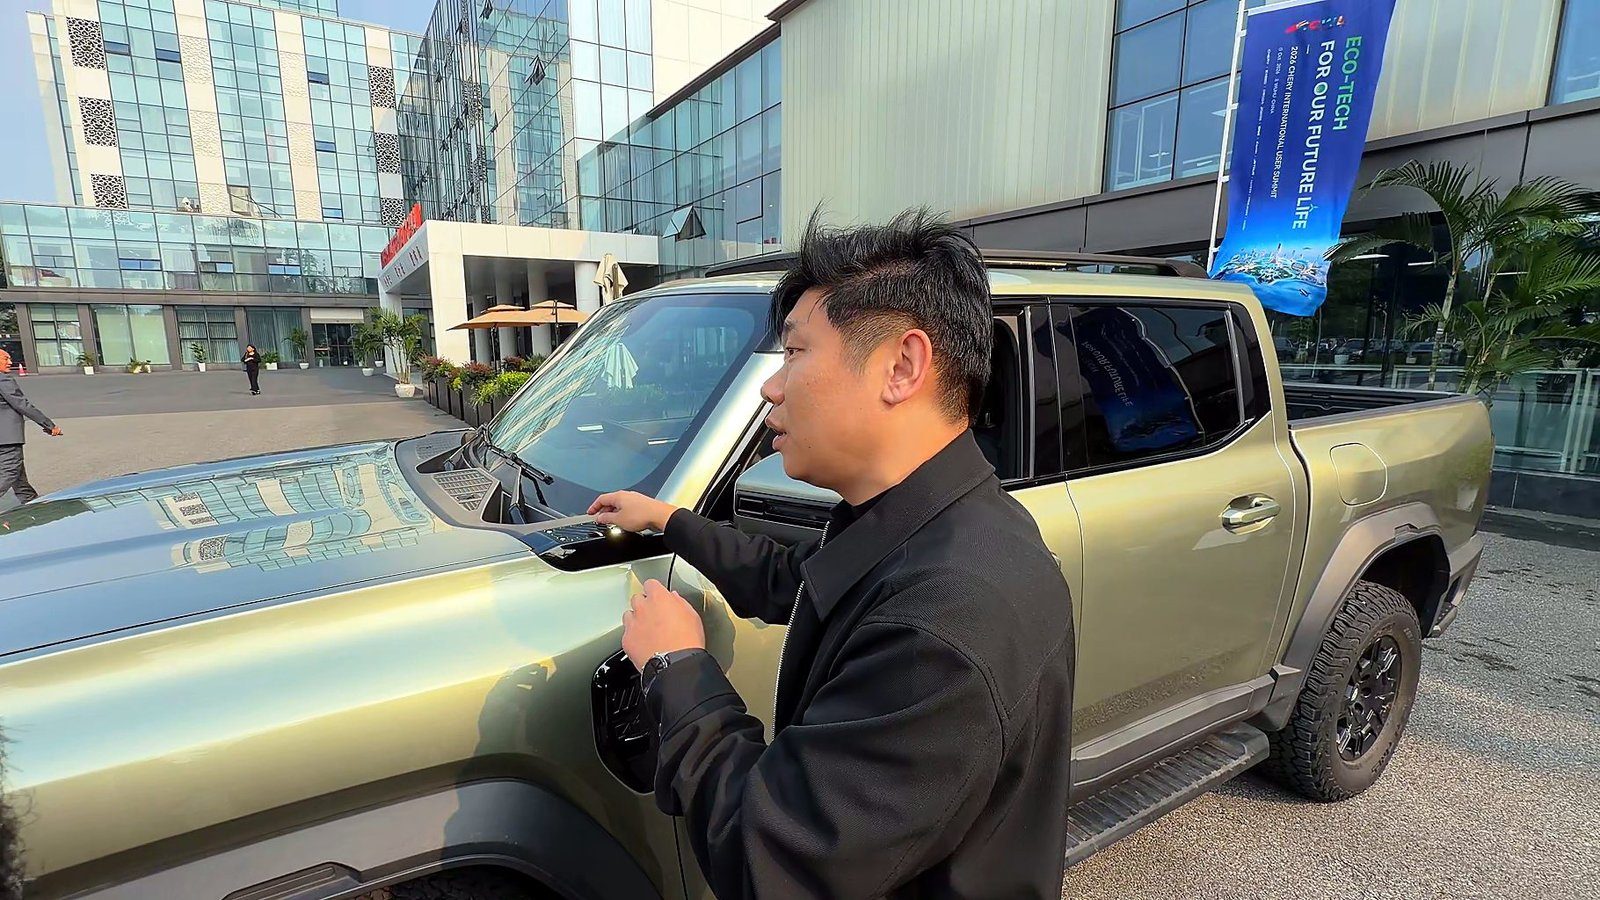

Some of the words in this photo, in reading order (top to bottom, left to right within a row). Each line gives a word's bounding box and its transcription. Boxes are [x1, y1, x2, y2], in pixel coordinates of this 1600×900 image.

[1289, 46, 1298, 65] 2026
[1315, 40, 1335, 79] FOR
[1286, 65, 1296, 91] CHERY
[1333, 36, 1362, 130] ECO-TECH
[1309, 82, 1328, 123] OUR
[1276, 92, 1292, 151] INTERNATIONAL
[1274, 151, 1283, 170] USER
[1299, 124, 1322, 193] FUTURE
[1270, 171, 1280, 199] SUMMIT
[1292, 197, 1313, 230] LIFE
